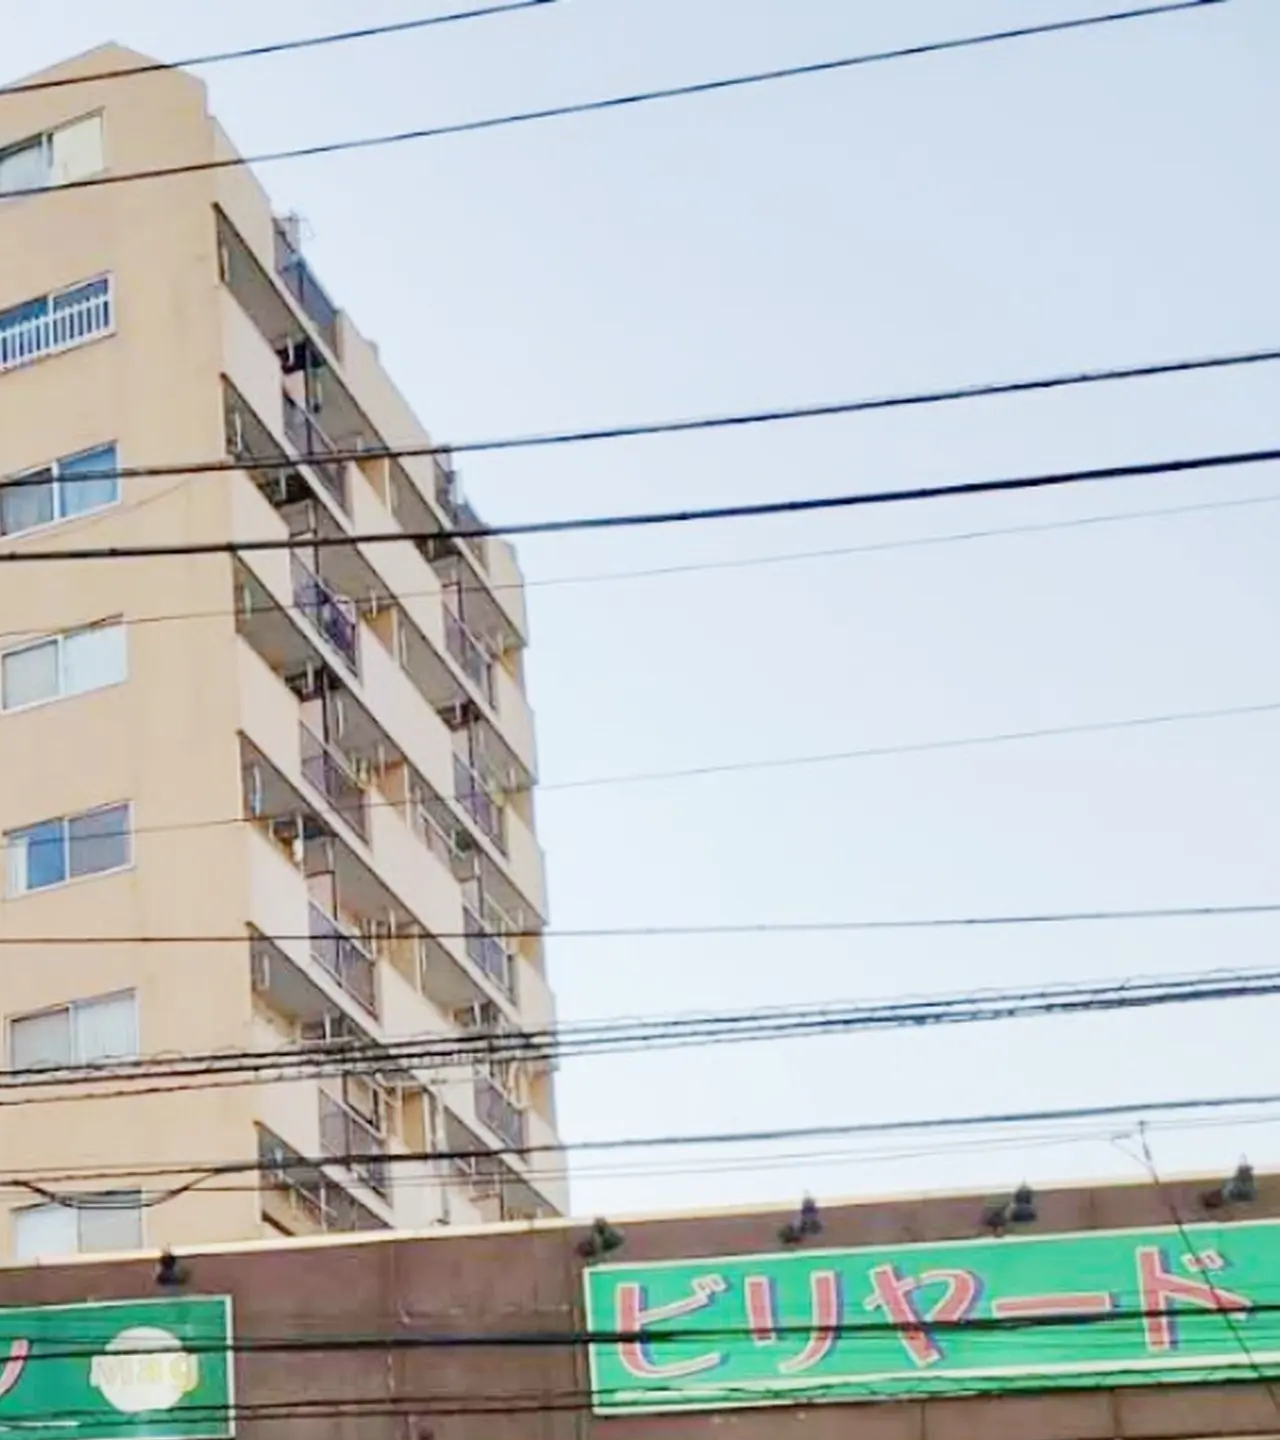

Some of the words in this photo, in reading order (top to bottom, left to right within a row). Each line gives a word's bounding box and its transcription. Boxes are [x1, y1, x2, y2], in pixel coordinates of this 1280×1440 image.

[614, 1246, 1255, 1379] ビリヤード
